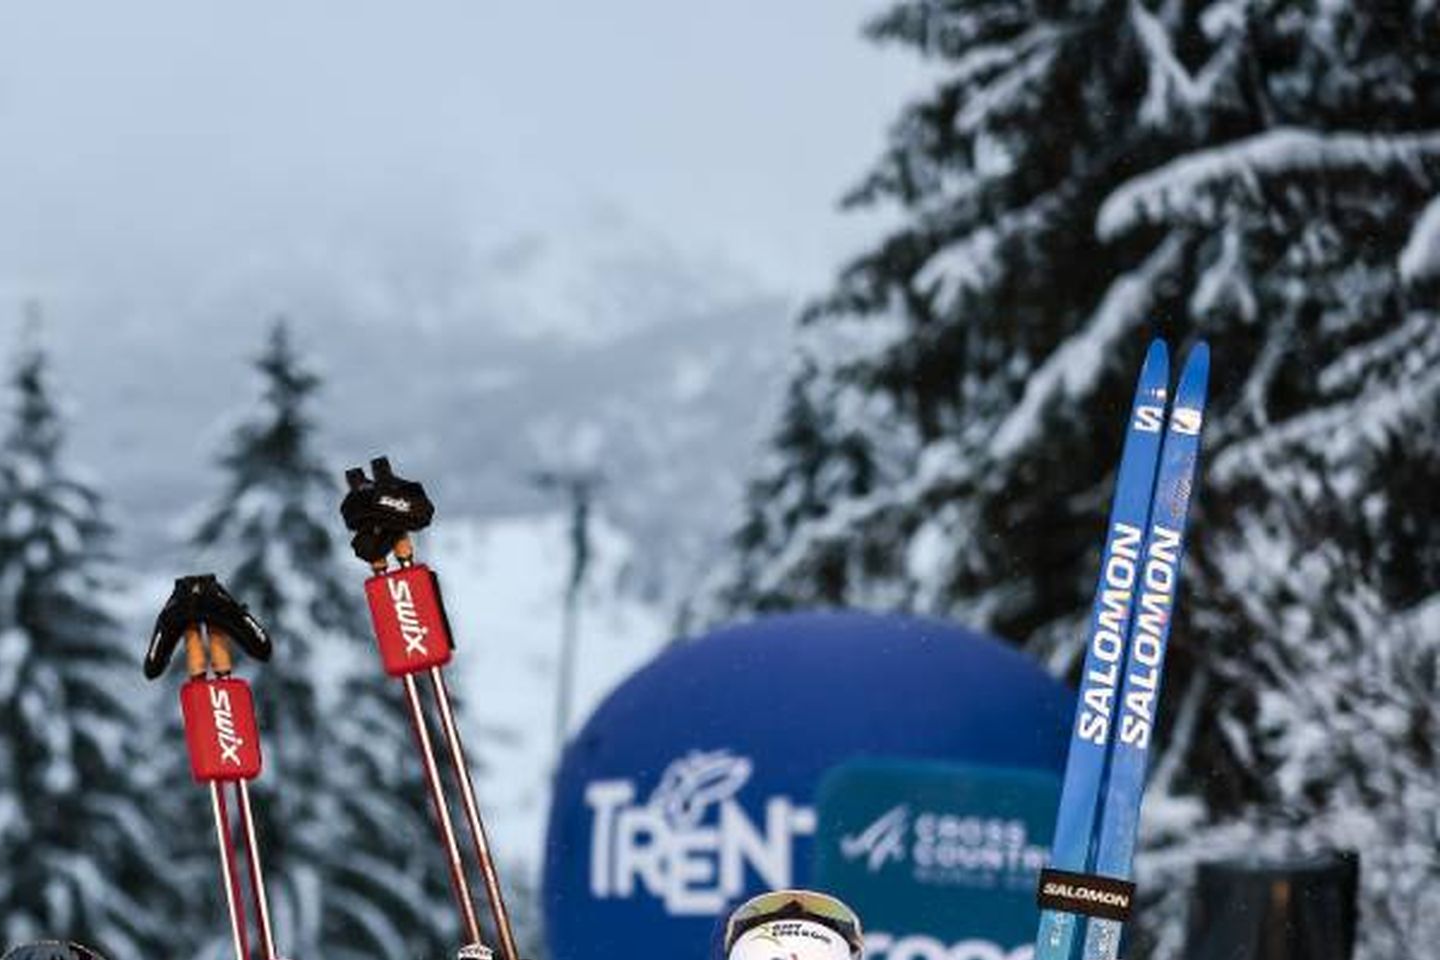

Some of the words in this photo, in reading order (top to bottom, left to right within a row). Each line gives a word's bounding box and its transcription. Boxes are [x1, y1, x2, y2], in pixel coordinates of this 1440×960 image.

[1077, 522, 1142, 745] SALOMON
[1120, 525, 1181, 749] SALOMON
[1043, 881, 1130, 907] SALOMON
